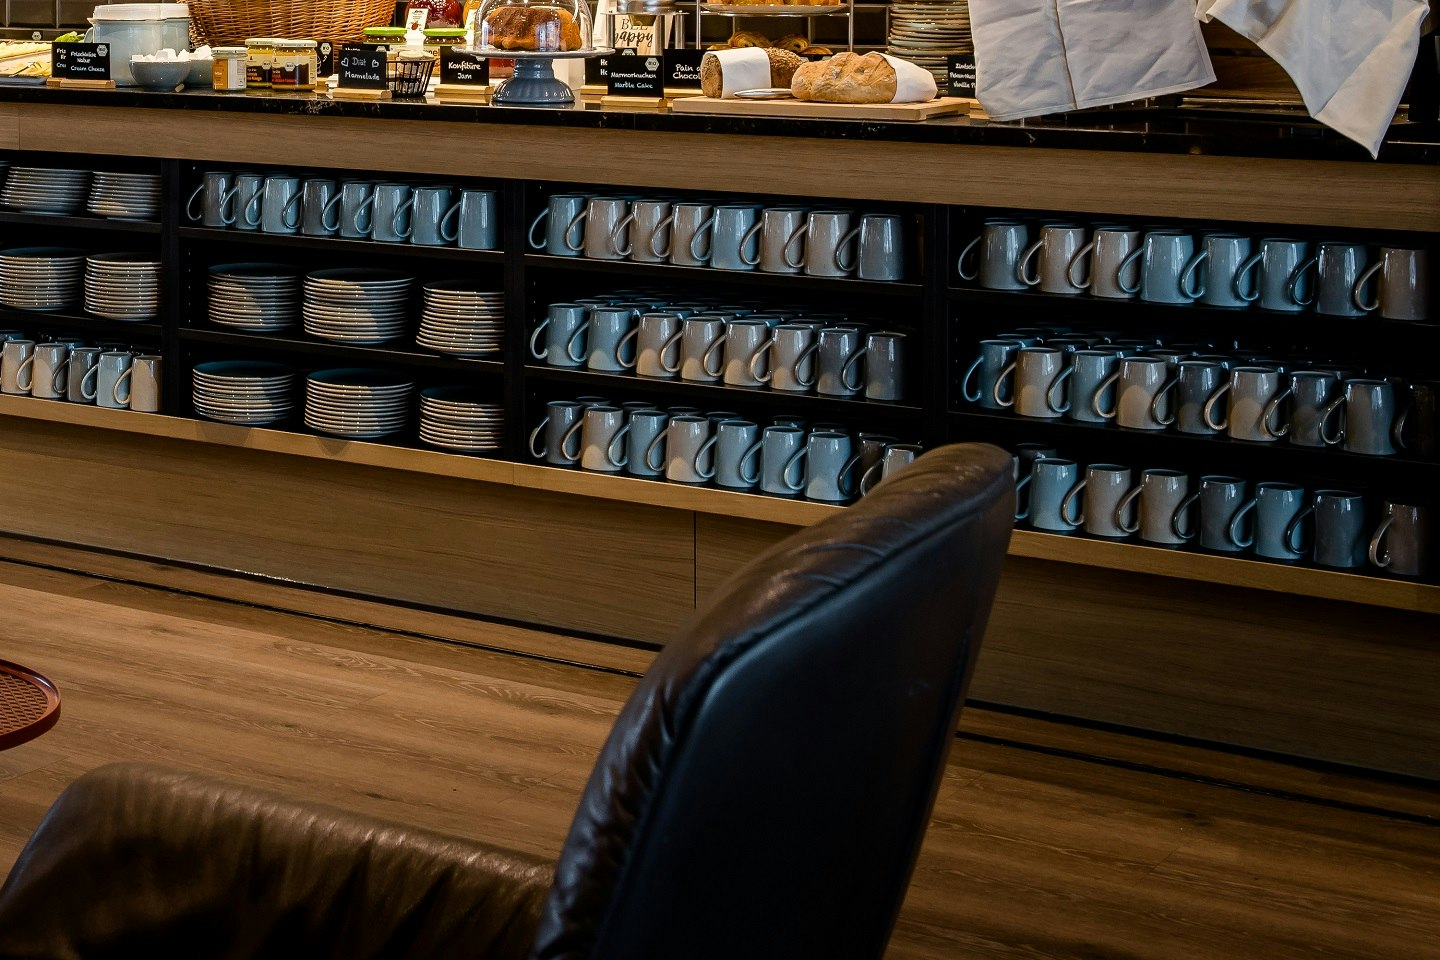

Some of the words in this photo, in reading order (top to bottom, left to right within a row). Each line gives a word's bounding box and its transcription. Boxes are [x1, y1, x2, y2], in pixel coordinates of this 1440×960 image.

[351, 56, 367, 66] Diät
[448, 61, 482, 71] Konfitüre
[675, 63, 693, 72] Pain
[344, 70, 380, 80] Marmelade
[457, 72, 472, 80] Jam
